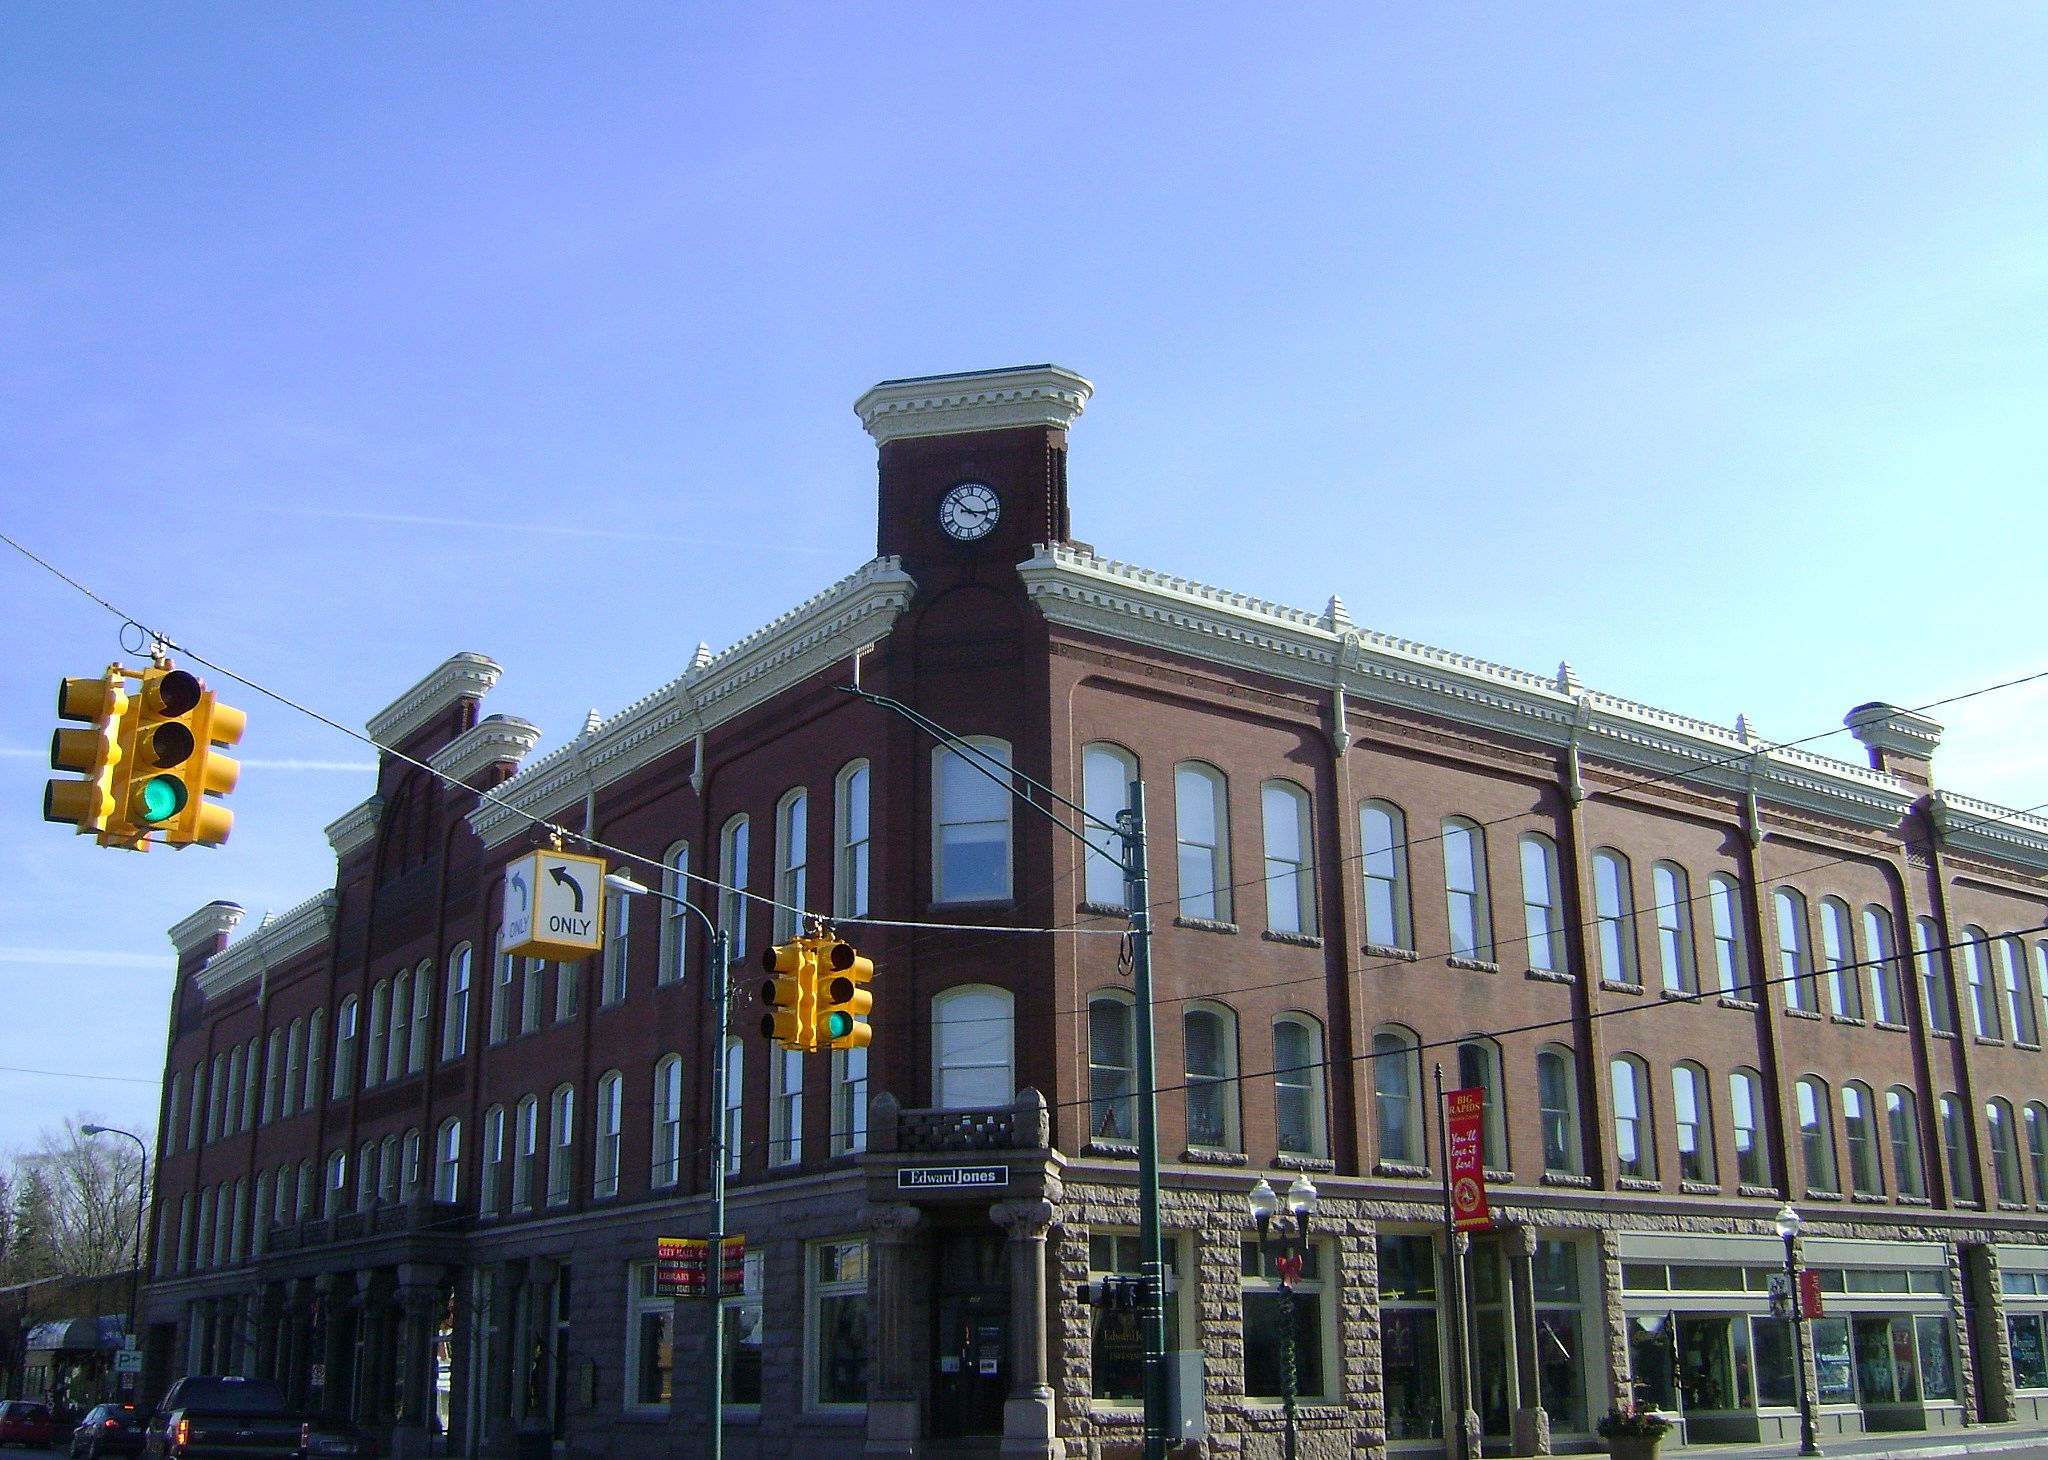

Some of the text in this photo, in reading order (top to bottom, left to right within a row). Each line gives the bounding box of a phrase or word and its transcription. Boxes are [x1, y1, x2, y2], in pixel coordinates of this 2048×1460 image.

[509, 914, 530, 938] ONLY
[549, 915, 592, 936] ONLY
[1456, 1094, 1473, 1105] BIG
[1449, 1103, 1480, 1114] RAPIDS
[659, 1248, 674, 1257] CITY
[659, 1271, 690, 1281] LIBRARY
[119, 1354, 130, 1367] P
